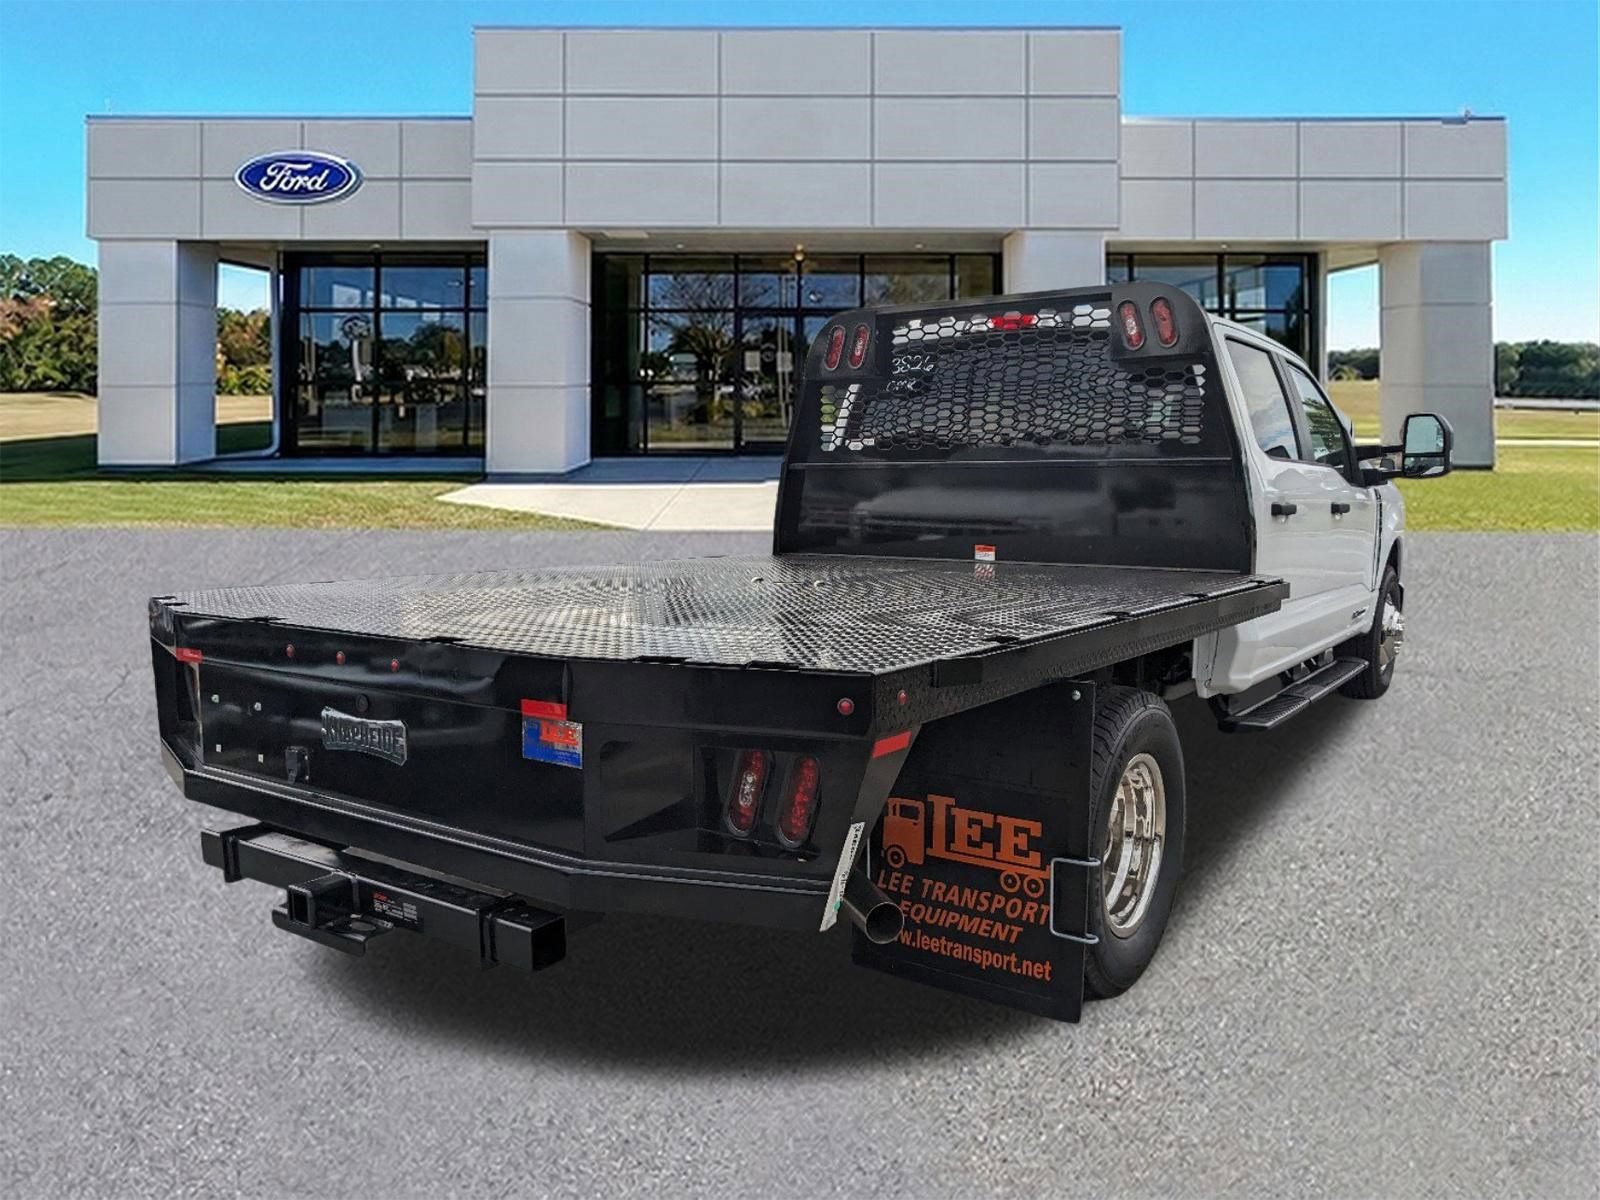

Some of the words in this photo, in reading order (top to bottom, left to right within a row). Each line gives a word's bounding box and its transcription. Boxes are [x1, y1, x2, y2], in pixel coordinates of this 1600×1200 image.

[259, 161, 331, 191] Ford
[926, 794, 1042, 868] LEE
[877, 869, 914, 894] LEE
[922, 878, 1050, 926] TRANSPORT
[900, 900, 1024, 943] EQUIPMENT
[895, 928, 1052, 981] w.leetransport.net
